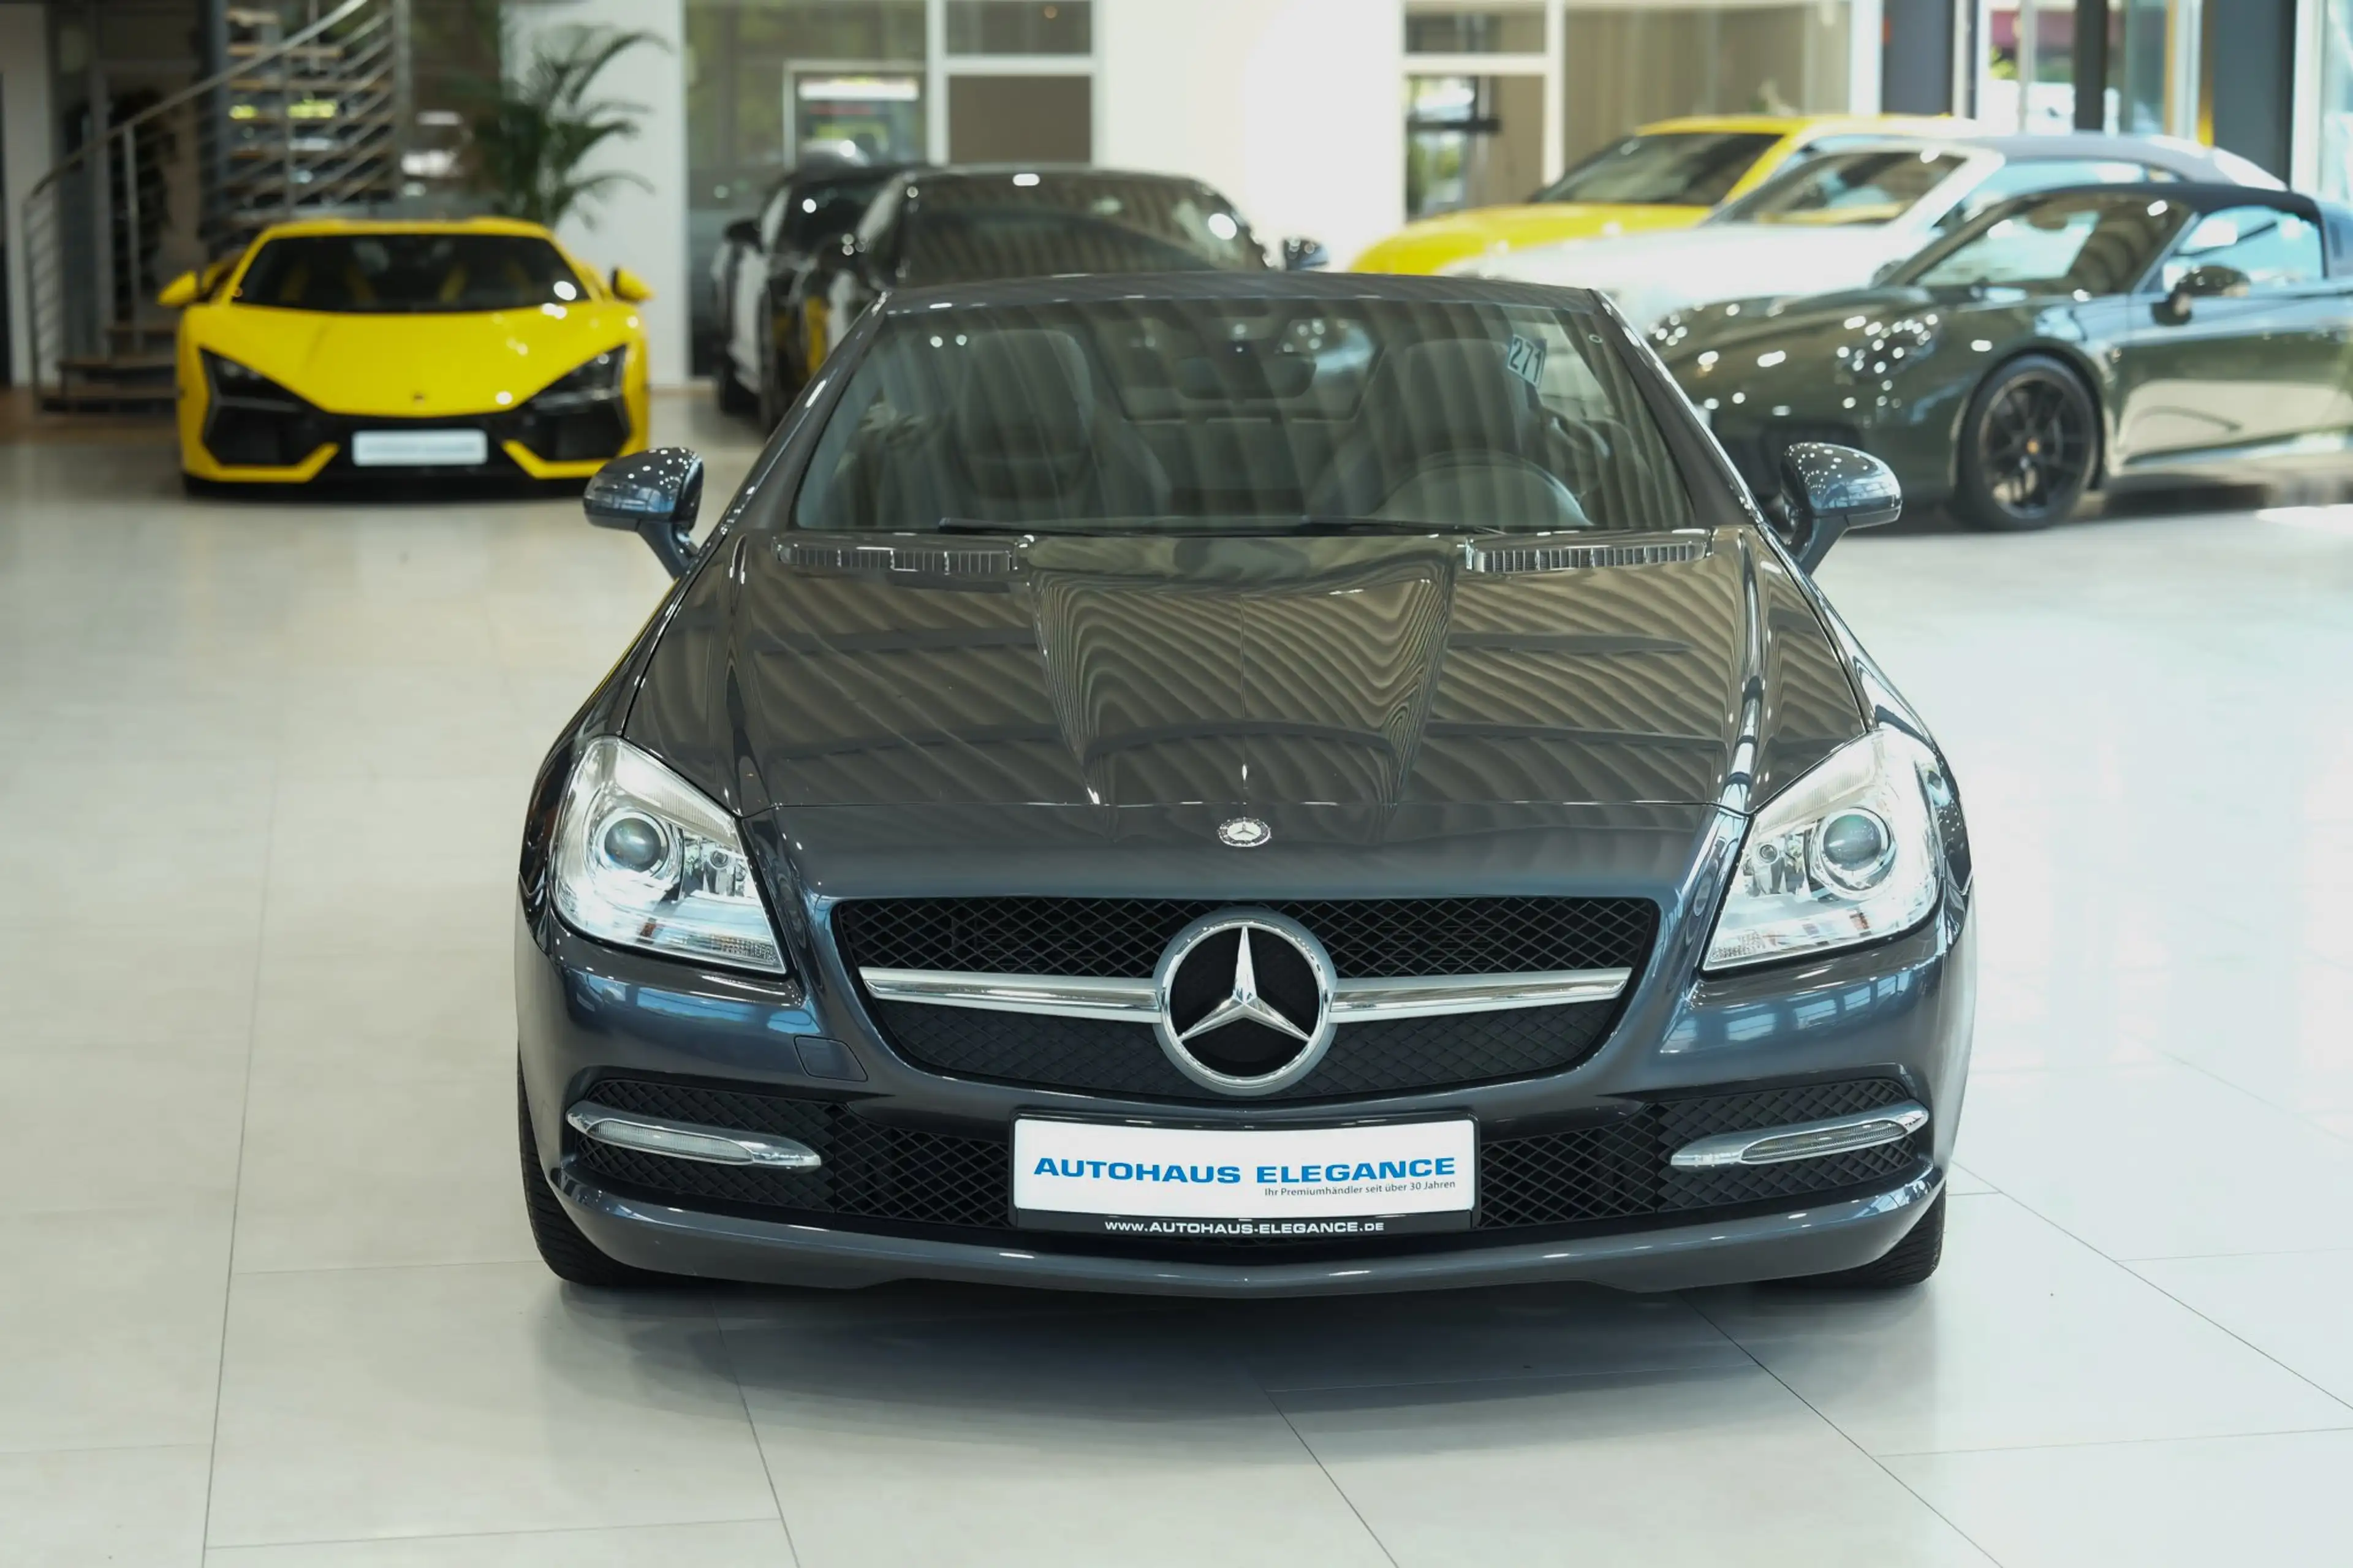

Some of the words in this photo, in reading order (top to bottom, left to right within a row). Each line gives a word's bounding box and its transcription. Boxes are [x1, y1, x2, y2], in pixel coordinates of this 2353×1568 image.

[1510, 337, 1543, 383] 271
[1033, 1157, 1241, 1184] AUTOHAUS
[1256, 1157, 1455, 1184] ELEGANCE
[1265, 1187, 1278, 1196] Ihr
[1281, 1186, 1363, 1195] Premiumhändler
[1365, 1184, 1382, 1193] seit
[1385, 1183, 1407, 1192] über
[1410, 1182, 1422, 1191] 30
[1424, 1181, 1455, 1190] Jahren
